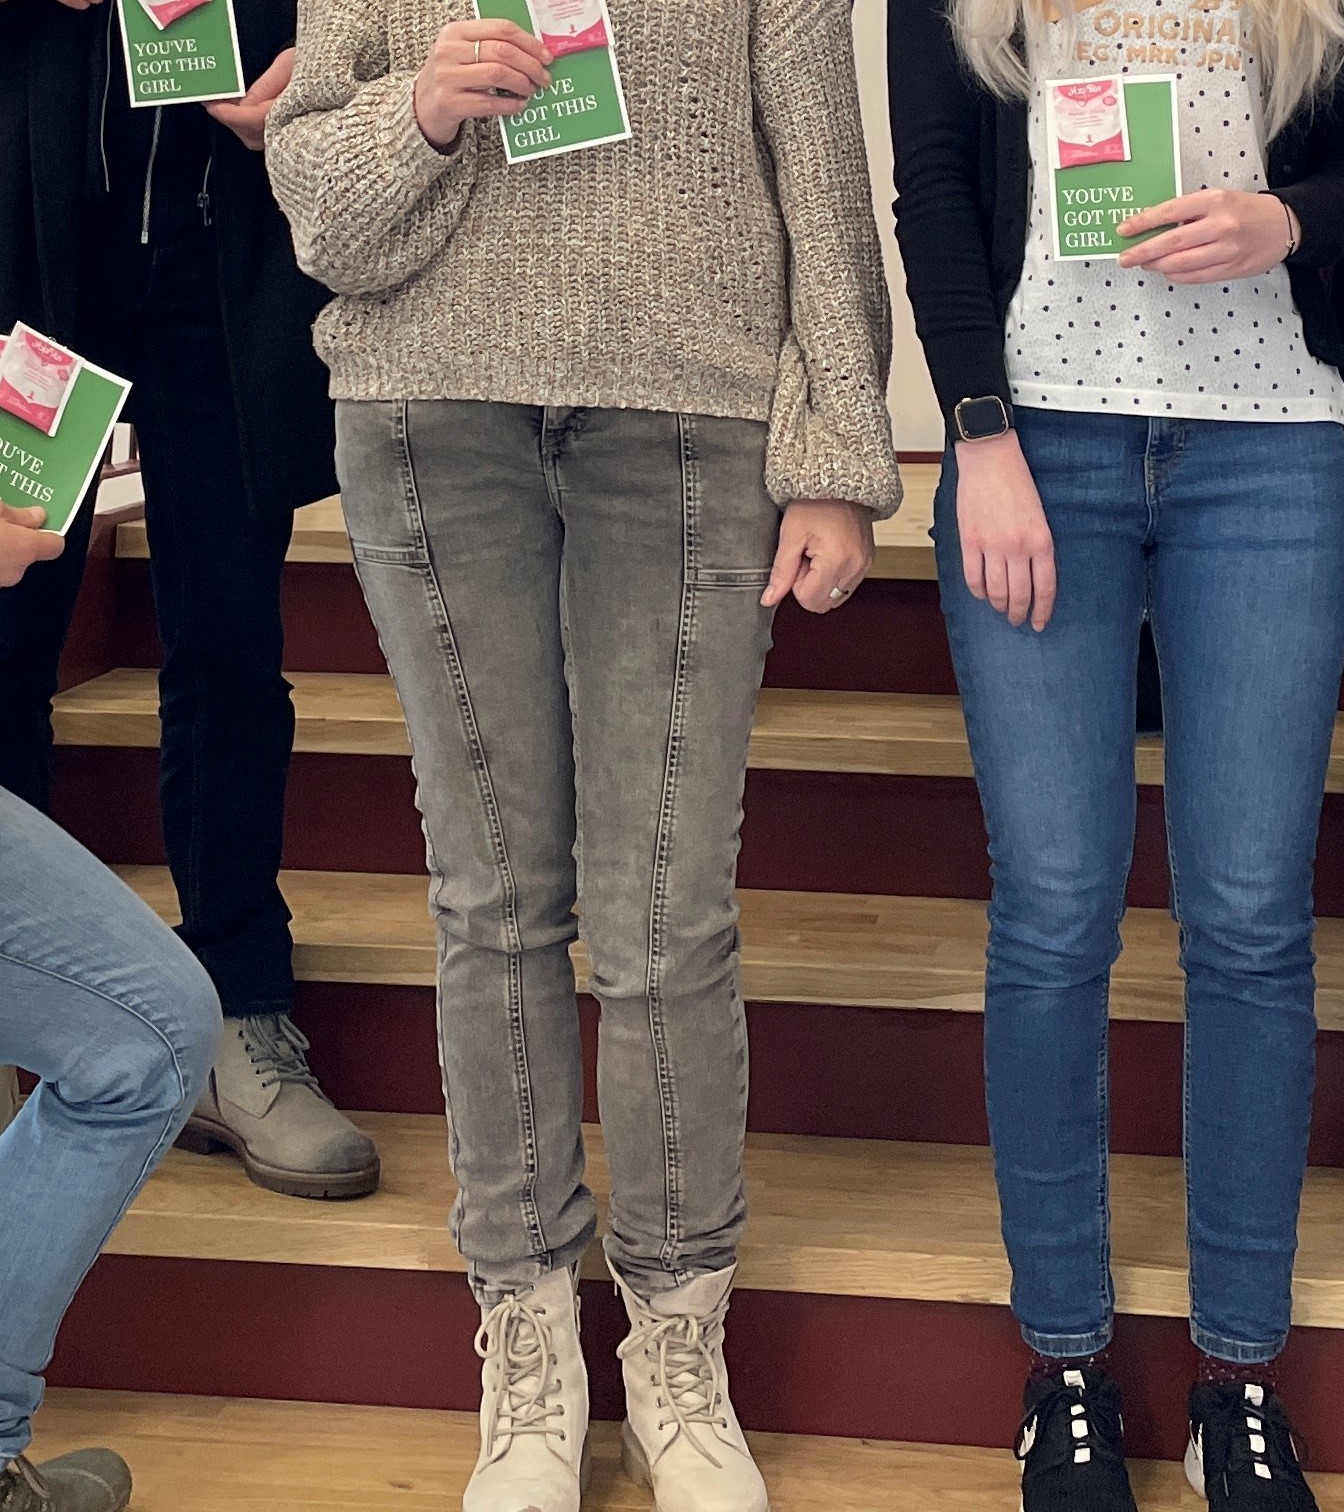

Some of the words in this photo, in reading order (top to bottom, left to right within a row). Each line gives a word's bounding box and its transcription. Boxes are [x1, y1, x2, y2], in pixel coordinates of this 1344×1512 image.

[1094, 9, 1238, 45] ORIGINA
[133, 38, 197, 57] YOU'VE
[137, 60, 172, 76] GOT
[176, 56, 216, 72] THIS
[139, 78, 182, 95] GIRL
[510, 105, 549, 127] GOT
[552, 95, 598, 117] THIS
[514, 126, 561, 148] GIRL
[1062, 186, 1134, 205] YOU'VE
[1064, 209, 1105, 227] GOT
[1065, 231, 1113, 248] GIRL
[10, 470, 54, 502] THIS
